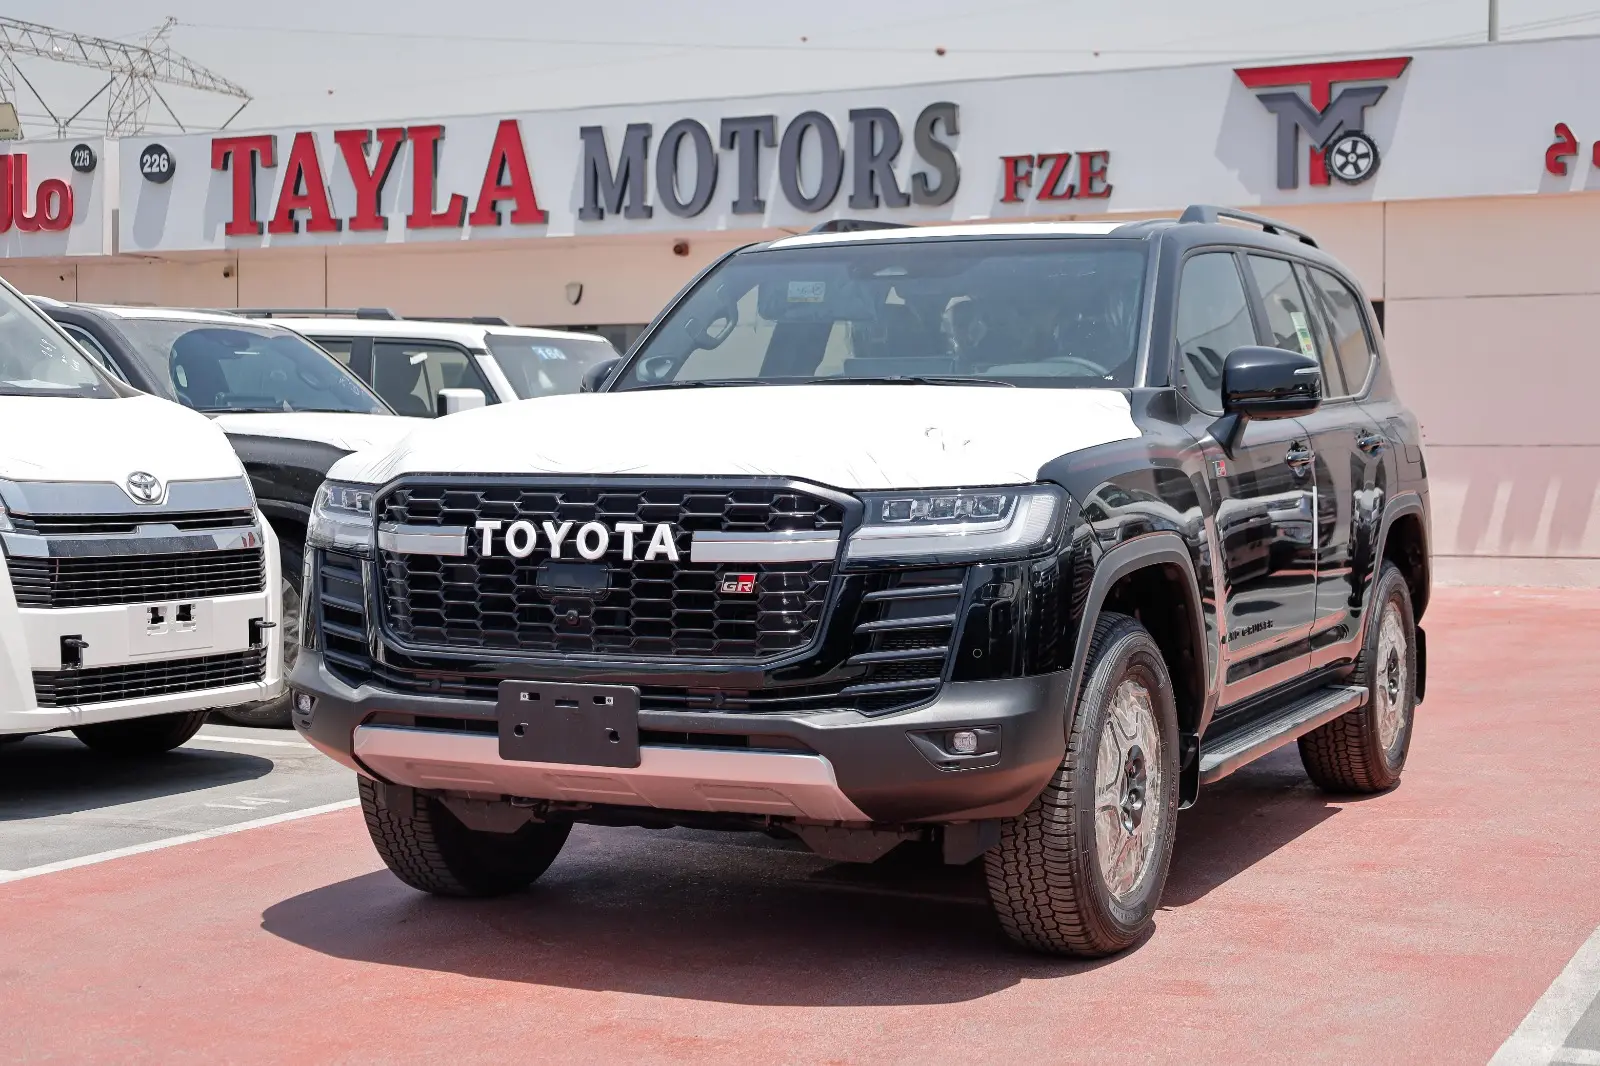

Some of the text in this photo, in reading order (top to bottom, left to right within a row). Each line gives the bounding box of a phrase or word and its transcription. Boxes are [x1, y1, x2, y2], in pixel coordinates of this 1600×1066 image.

[73, 150, 91, 167] 225
[142, 153, 169, 174] 226
[210, 101, 1112, 236] TAYLA MOTORS FZE
[475, 519, 680, 562] TOYOTA
